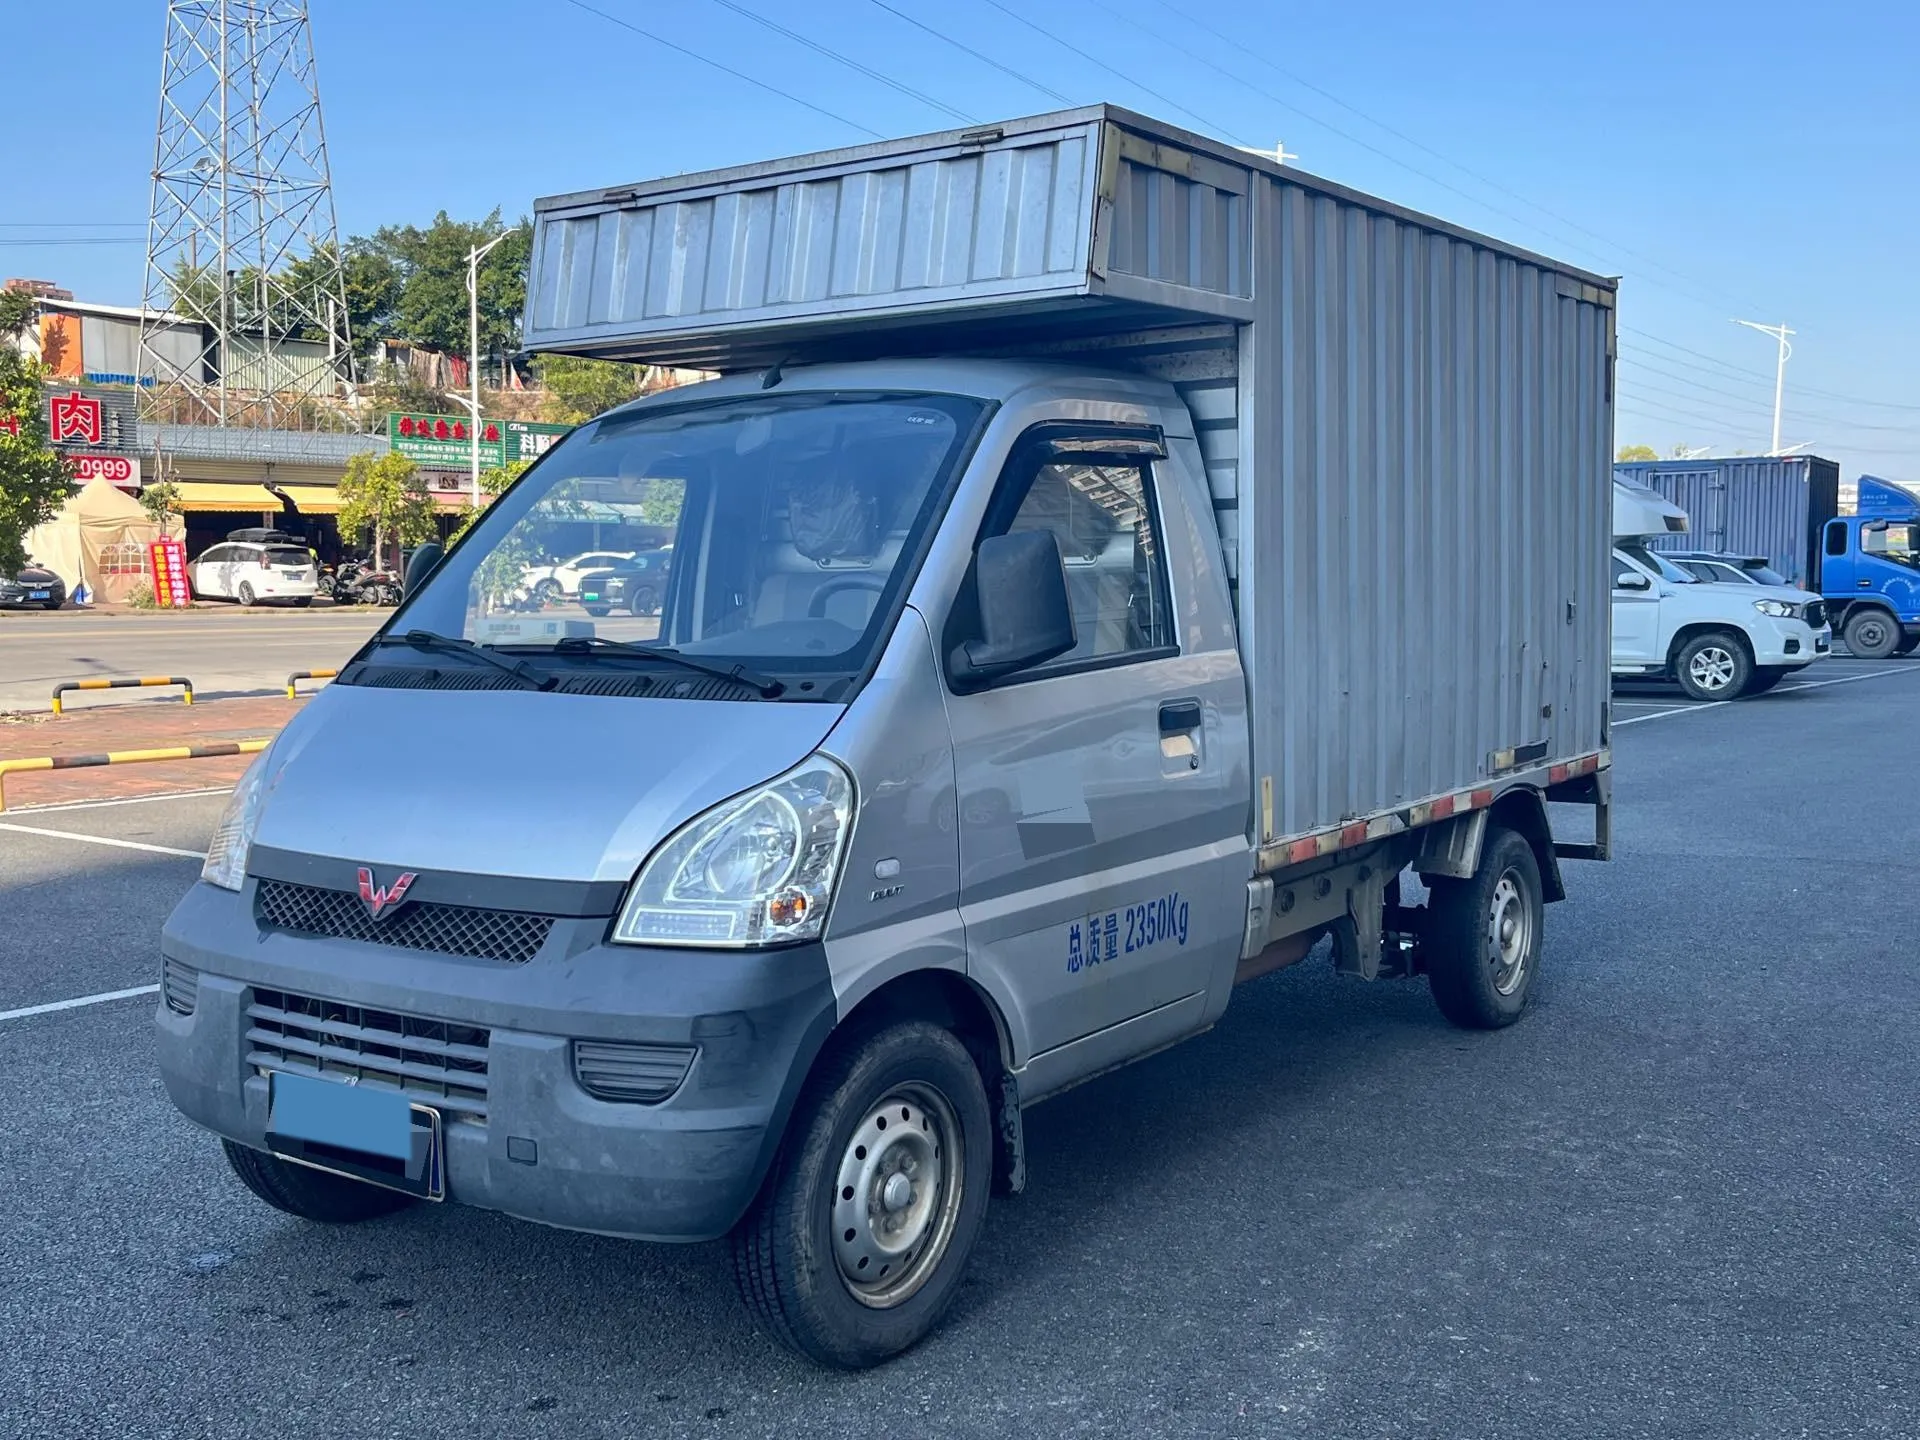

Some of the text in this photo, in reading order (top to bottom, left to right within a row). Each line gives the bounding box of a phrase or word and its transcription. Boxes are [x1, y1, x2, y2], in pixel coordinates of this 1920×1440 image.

[50, 391, 101, 444] 肉
[520, 433, 561, 454] 科顺
[1067, 892, 1189, 973] 总质量 2350Kg
